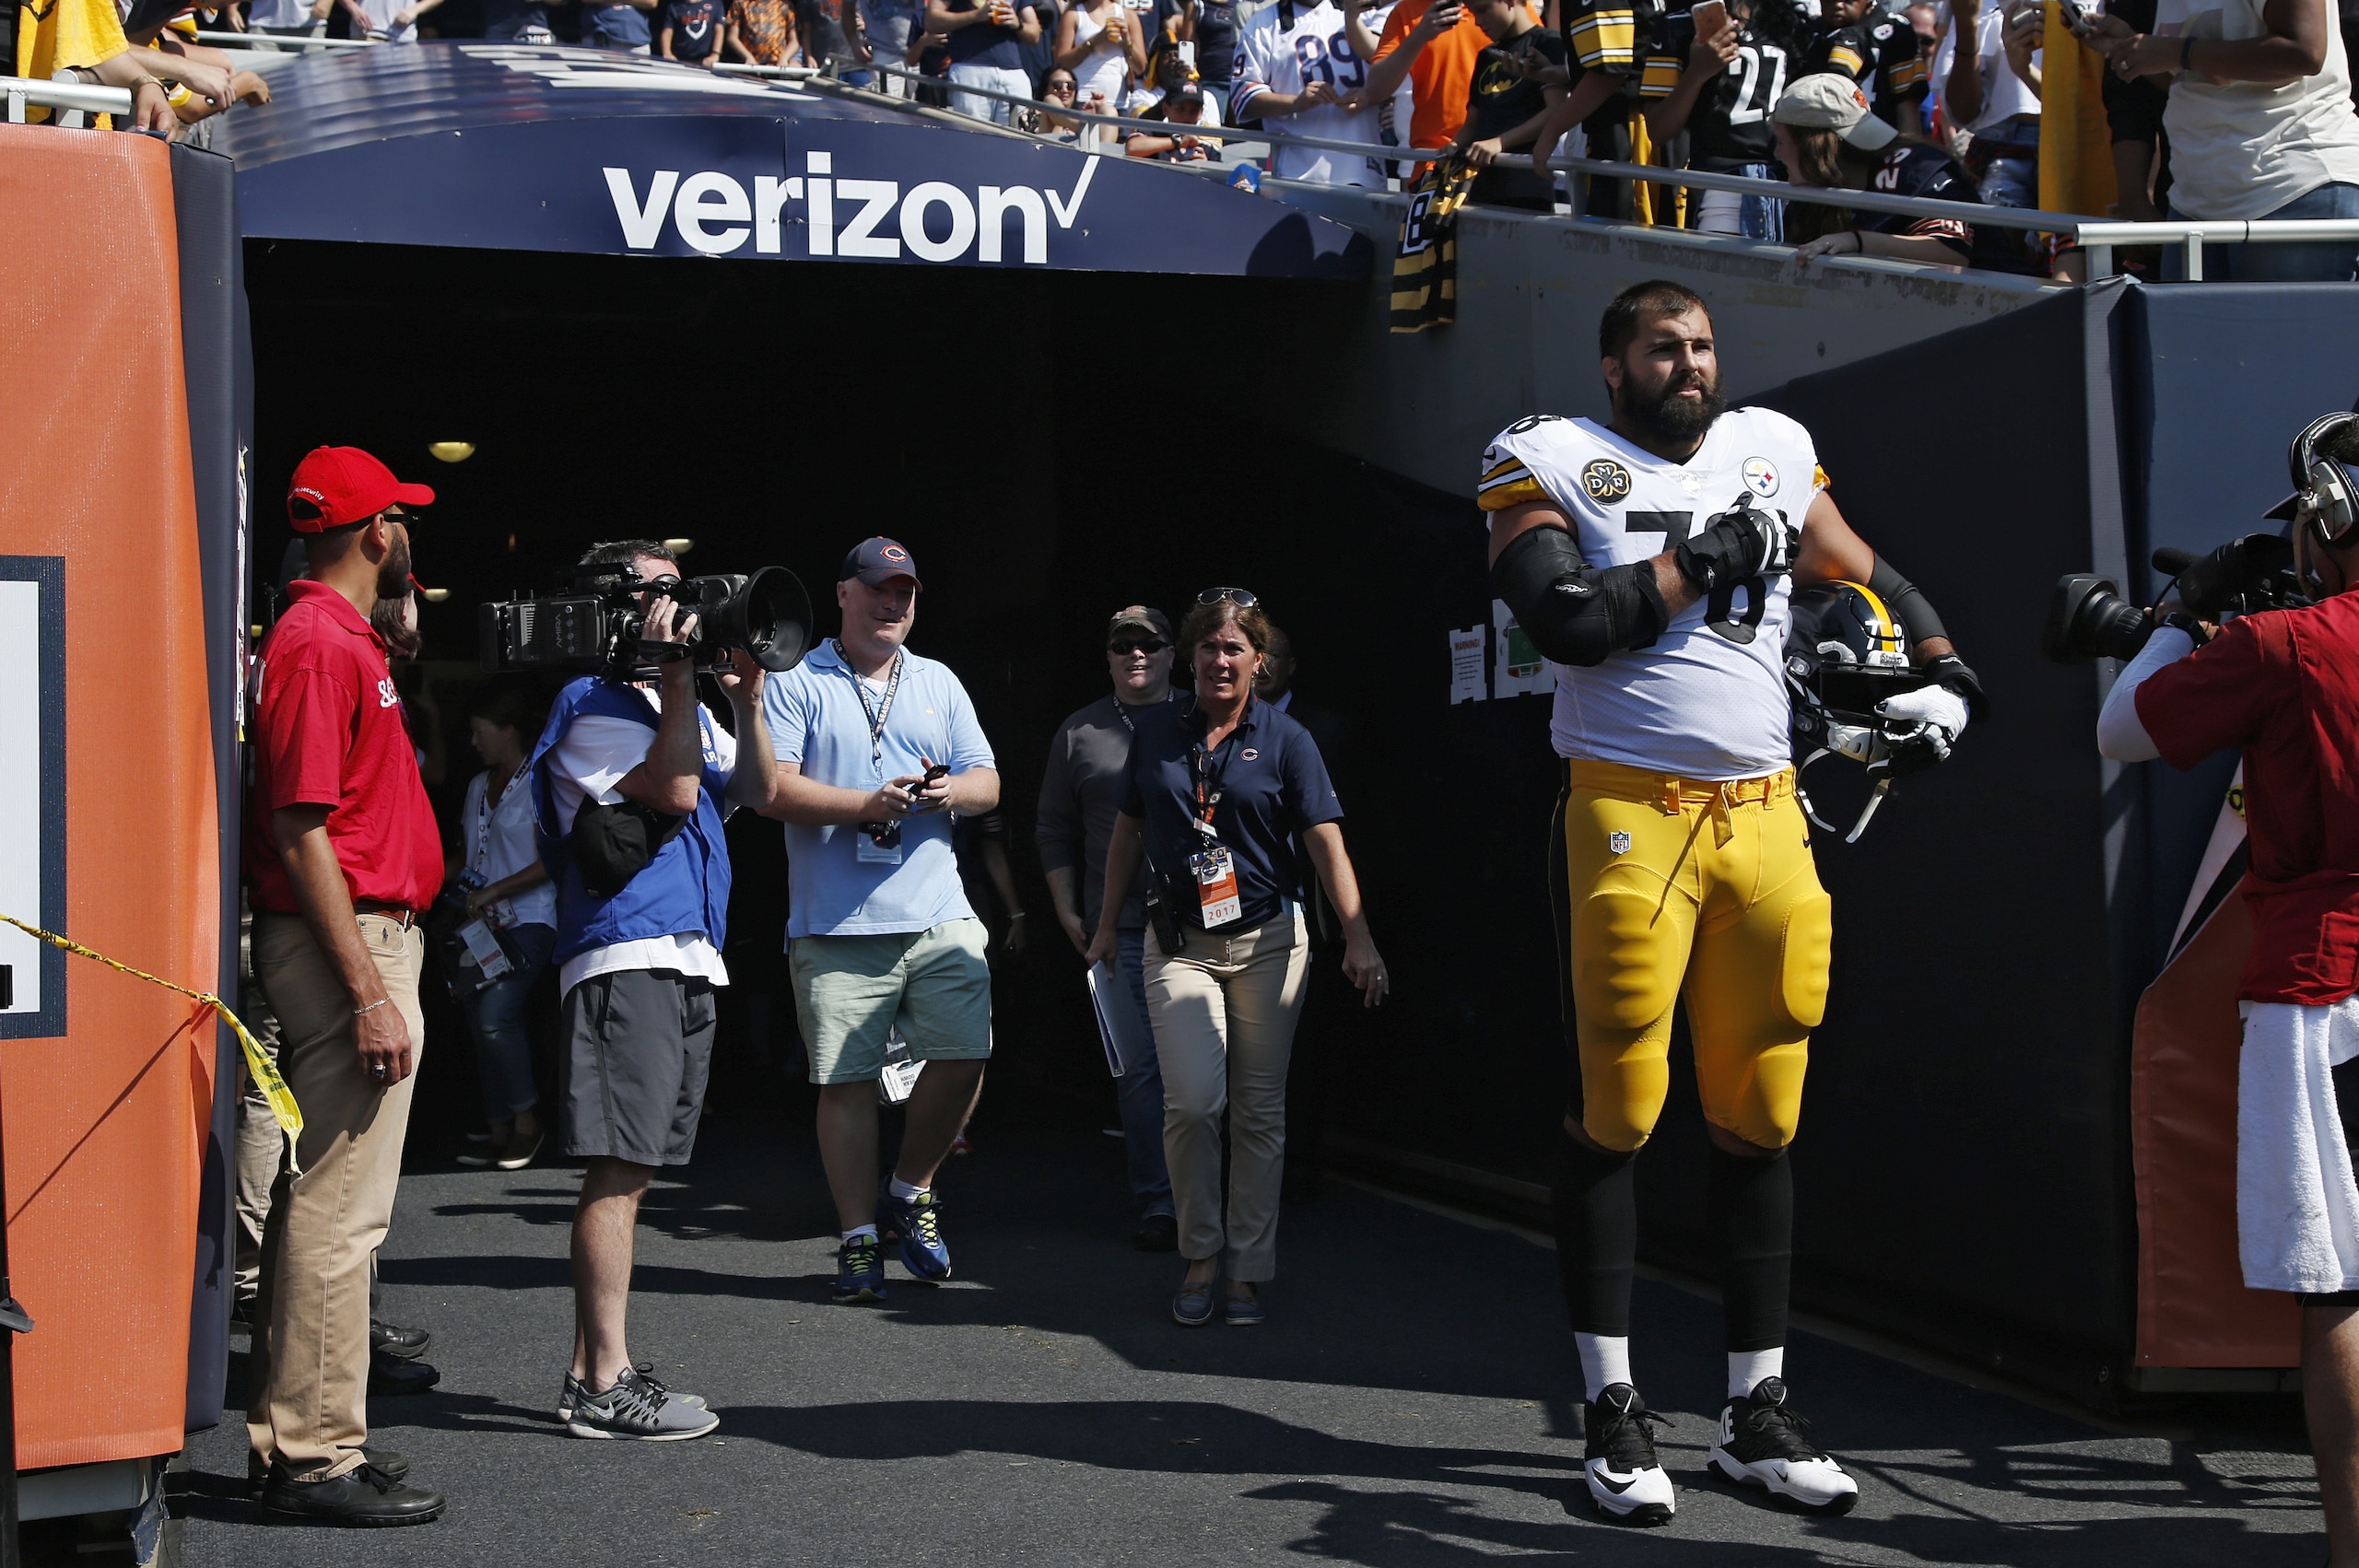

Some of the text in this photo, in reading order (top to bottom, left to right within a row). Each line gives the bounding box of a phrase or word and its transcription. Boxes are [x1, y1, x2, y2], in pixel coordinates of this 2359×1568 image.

[1295, 31, 1366, 88] 89
[1729, 44, 1787, 125] 27
[602, 150, 1048, 263] verizon
[1454, 638, 1480, 652] WARNING!
[877, 698, 892, 723] SEASON
[887, 673, 899, 698] TICKET
[1614, 840, 1627, 850] NFL
[1208, 904, 1235, 920] 2017
